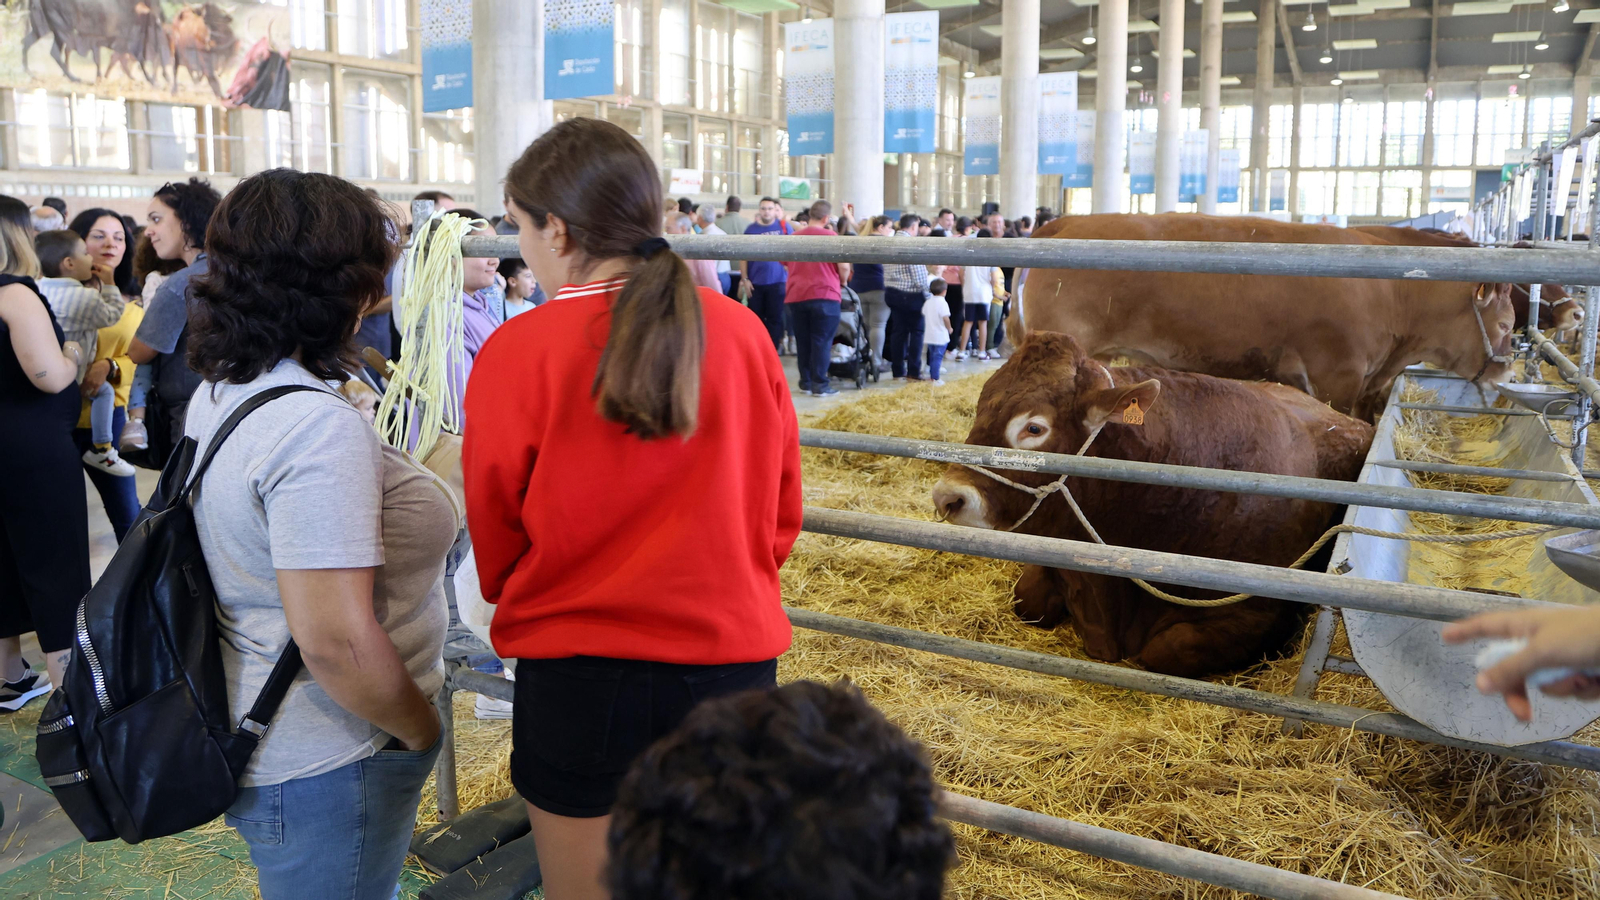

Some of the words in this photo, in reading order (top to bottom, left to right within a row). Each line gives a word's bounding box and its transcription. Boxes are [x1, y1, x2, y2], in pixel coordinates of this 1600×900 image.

[890, 21, 932, 35] IFECA
[790, 29, 829, 43] IFECA
[1124, 415, 1142, 424] 0938
